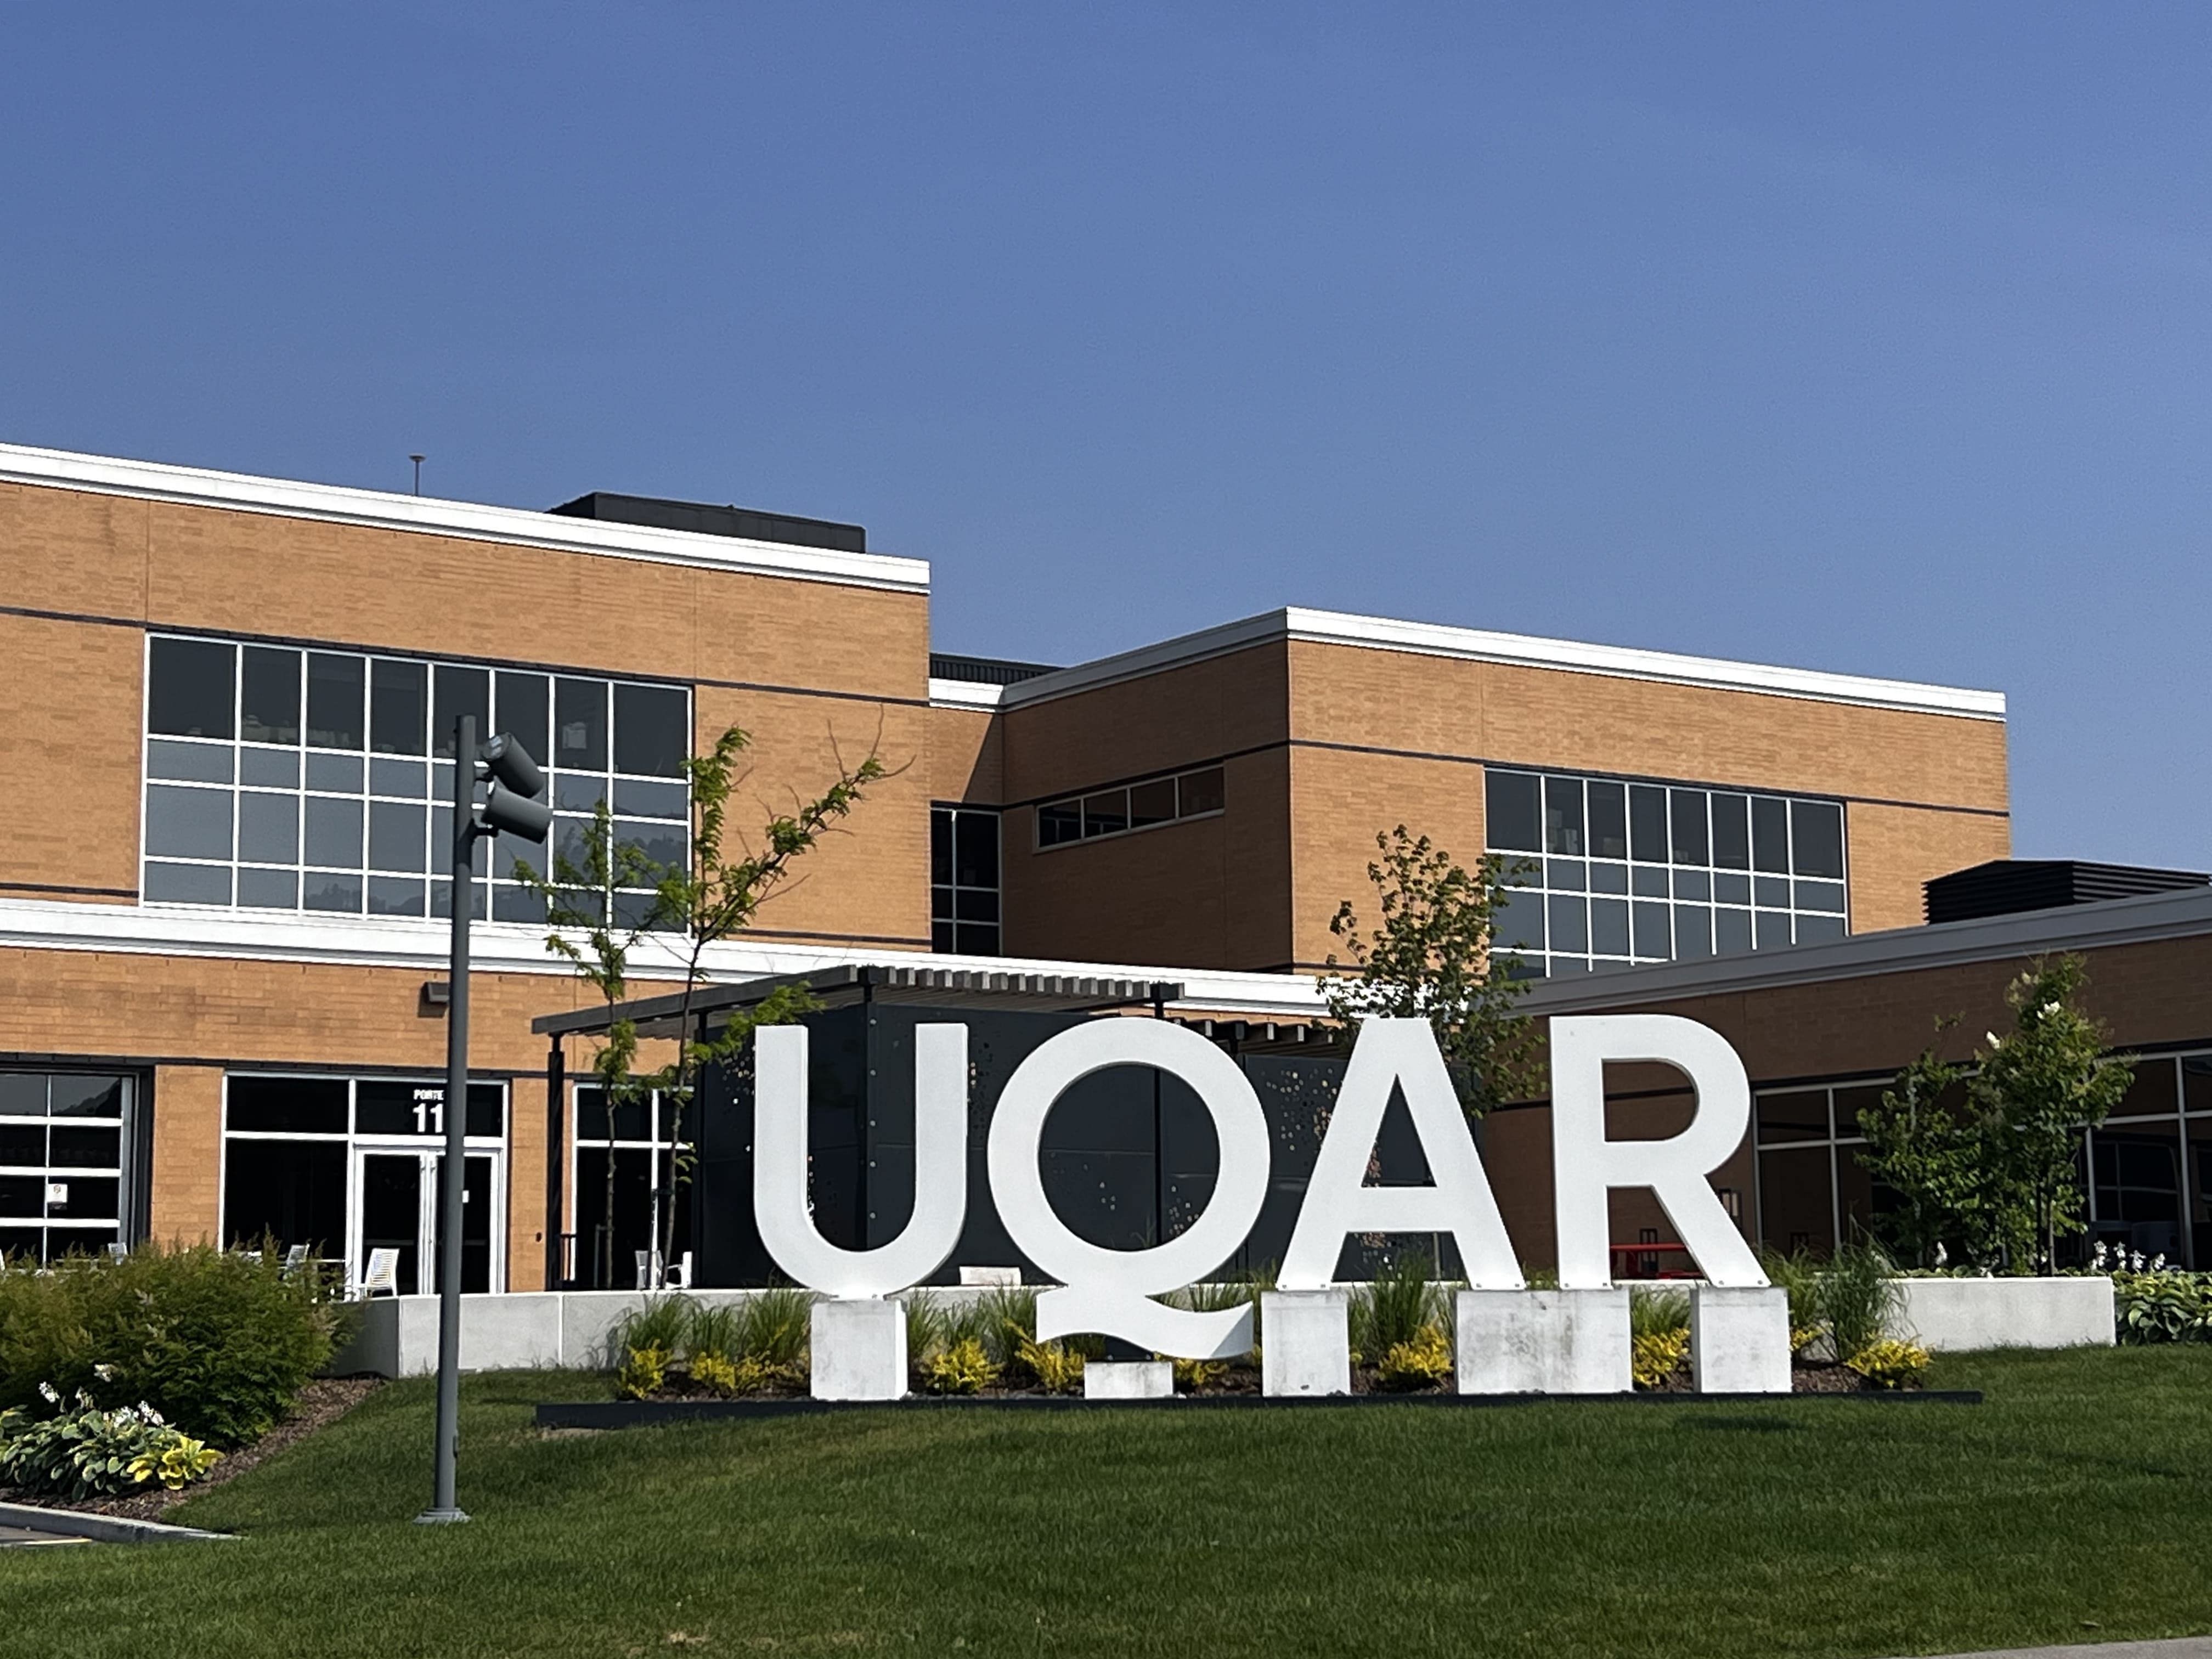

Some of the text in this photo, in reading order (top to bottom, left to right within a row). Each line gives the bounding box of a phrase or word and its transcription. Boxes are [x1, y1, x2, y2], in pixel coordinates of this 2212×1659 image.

[413, 1089, 444, 1101] PORTE
[413, 1102, 444, 1133] 11
[753, 1014, 1771, 1360] UQAR
